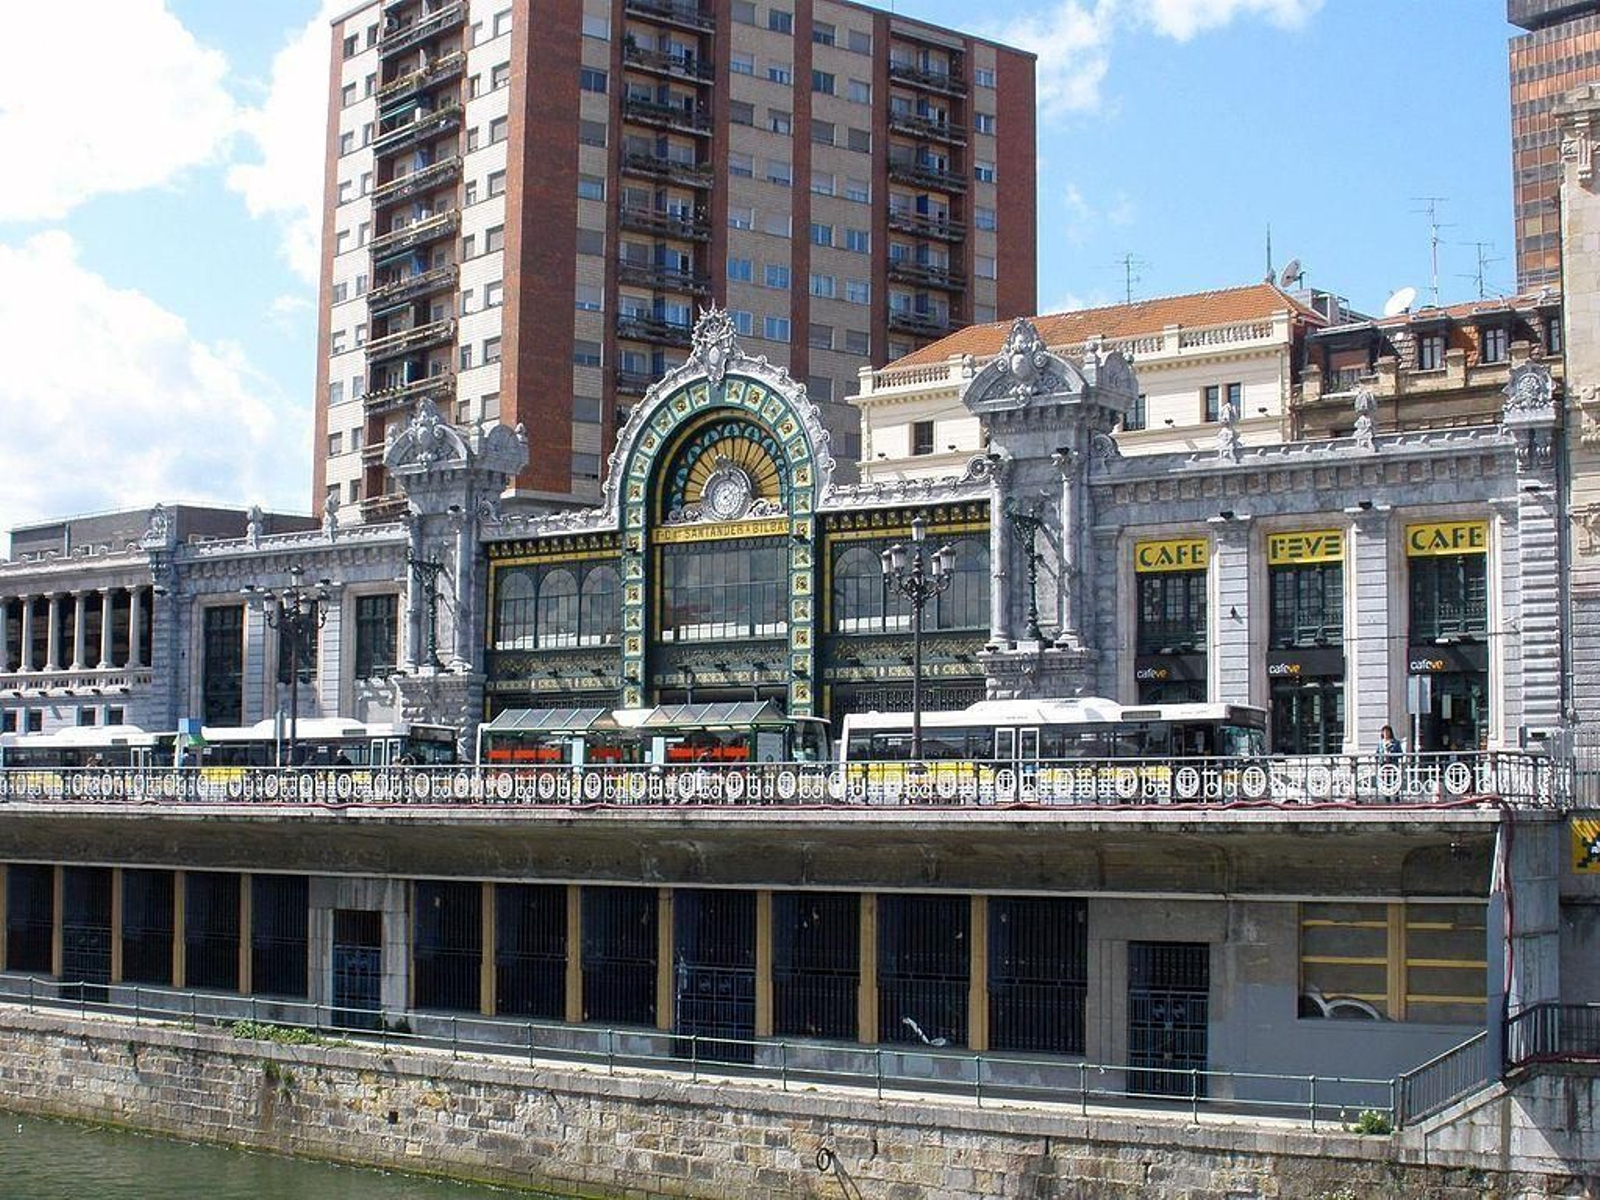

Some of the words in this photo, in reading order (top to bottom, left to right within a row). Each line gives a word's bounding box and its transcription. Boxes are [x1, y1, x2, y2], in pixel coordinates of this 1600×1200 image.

[685, 524, 743, 539] SANTANDER
[1411, 526, 1483, 550] CAFE
[1140, 543, 1204, 567] CAFE
[1271, 535, 1340, 559] FEVE
